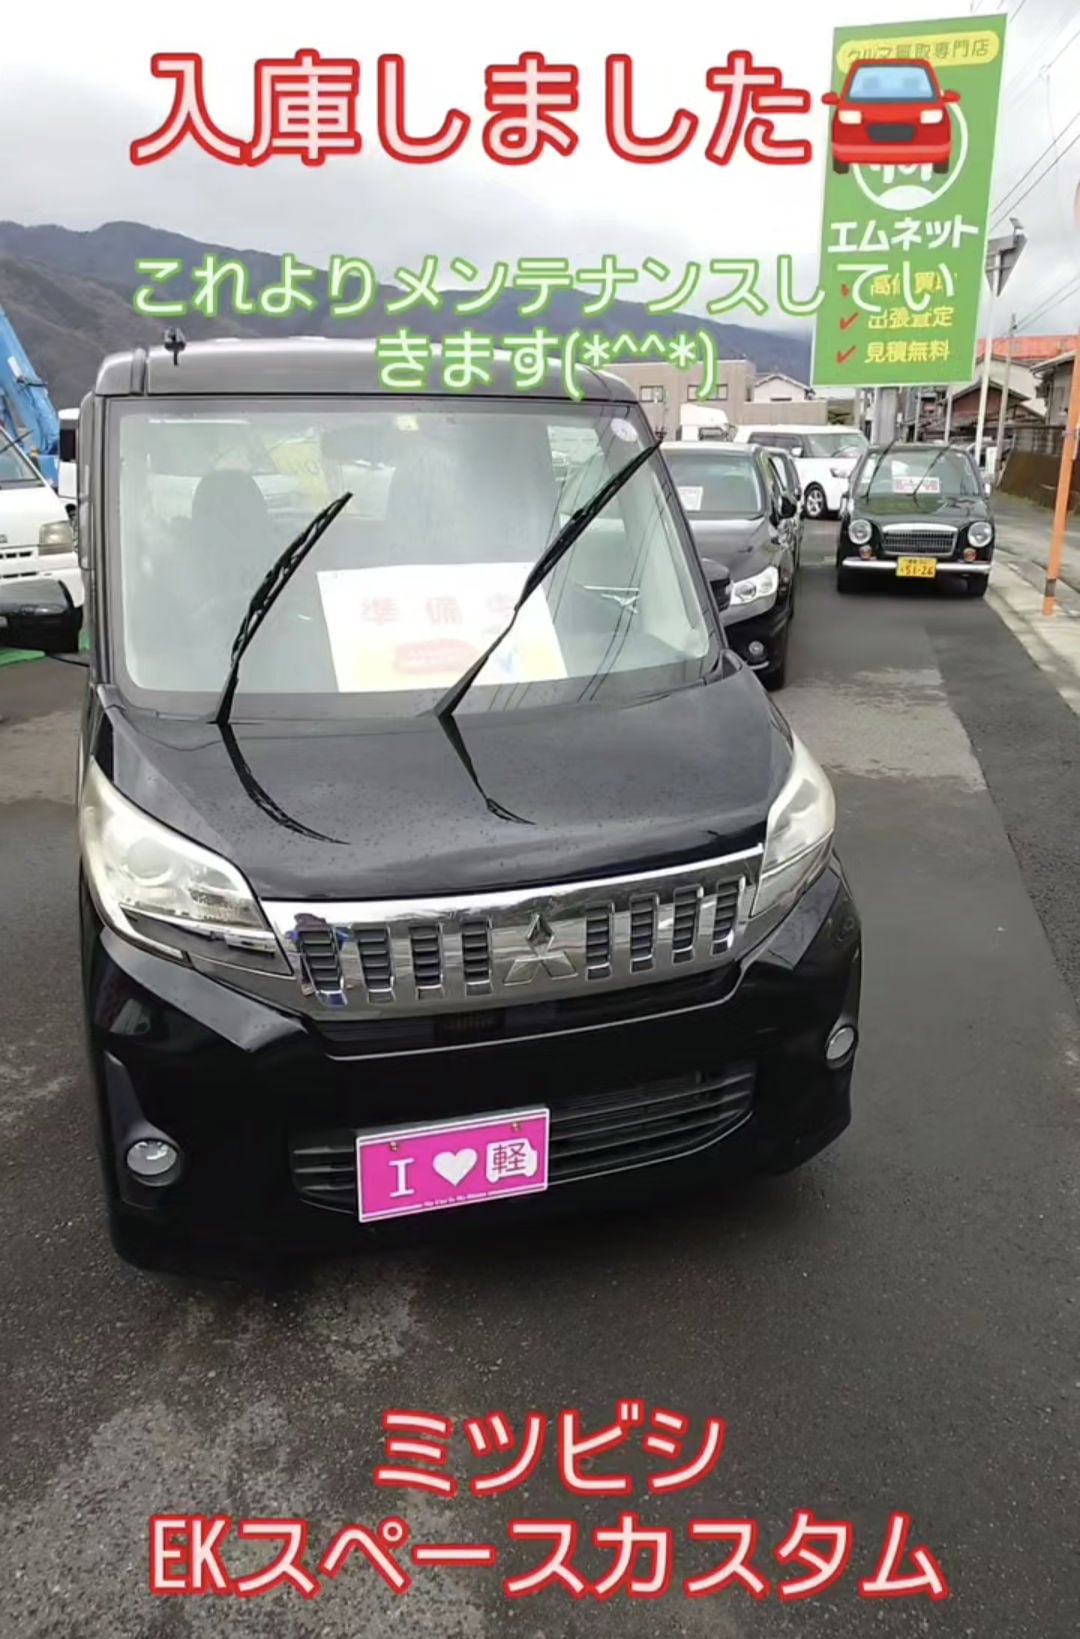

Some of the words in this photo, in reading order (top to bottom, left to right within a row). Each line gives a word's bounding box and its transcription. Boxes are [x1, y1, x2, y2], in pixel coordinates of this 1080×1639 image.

[827, 215, 979, 254] エムネット
[865, 305, 954, 329] 出張査定
[863, 339, 950, 364] 見積無料
[388, 1157, 415, 1198] I
[491, 1141, 527, 1175] 軽
